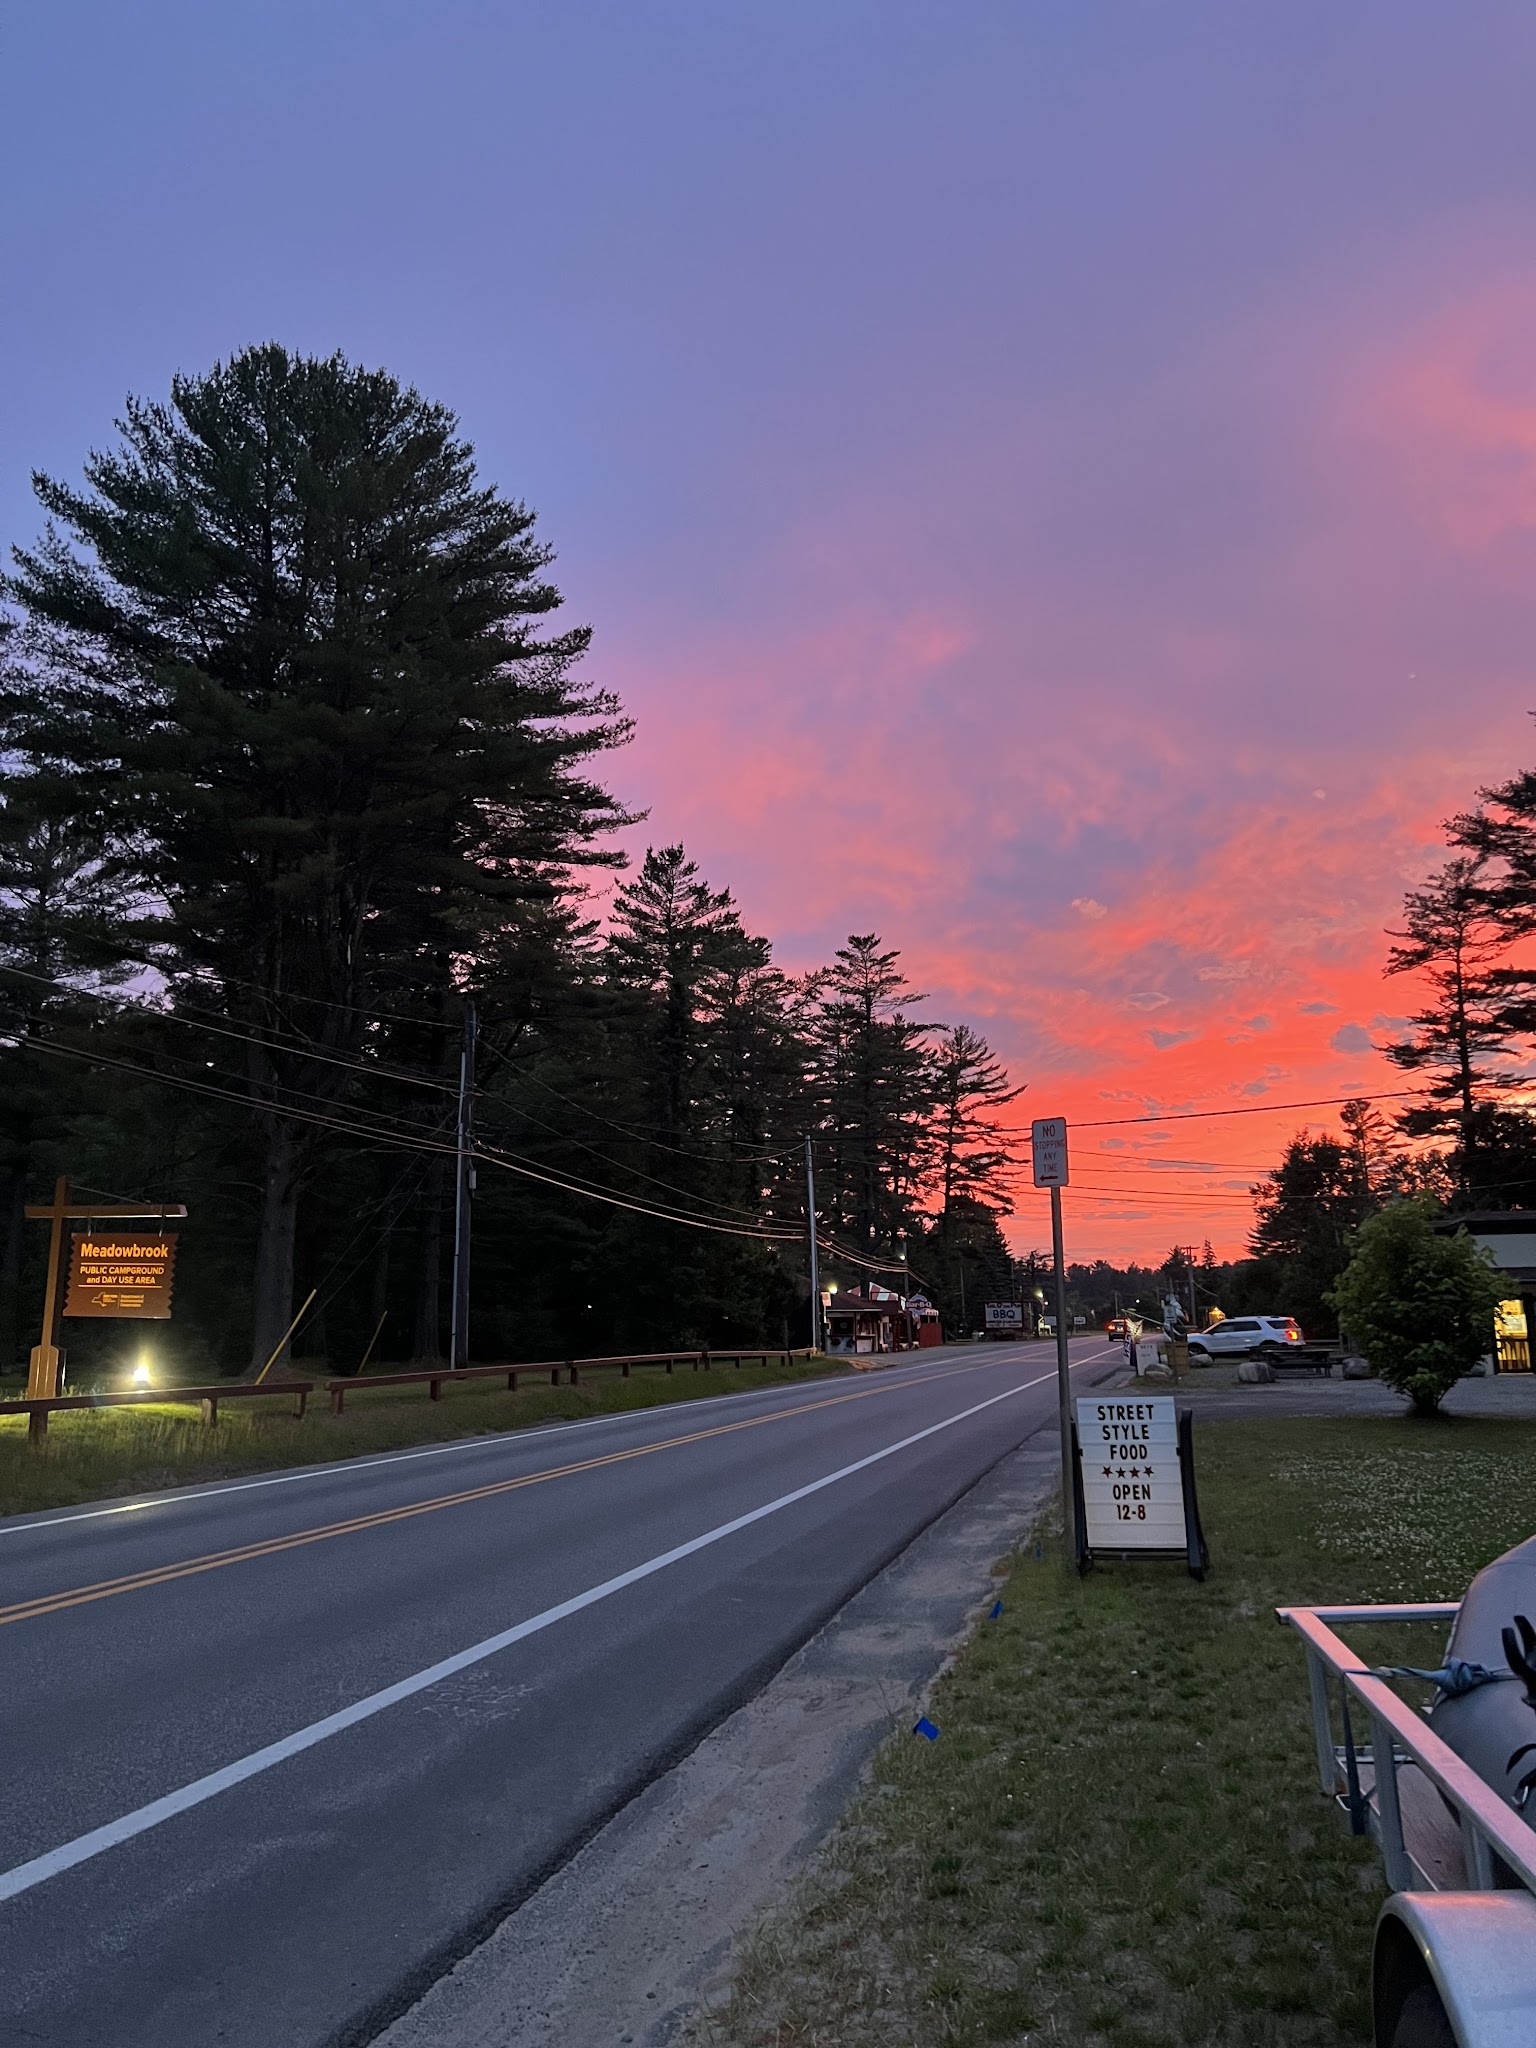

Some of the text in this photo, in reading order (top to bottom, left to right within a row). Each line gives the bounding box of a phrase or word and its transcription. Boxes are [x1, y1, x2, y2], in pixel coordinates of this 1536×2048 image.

[1042, 1124, 1056, 1138] NO
[1035, 1139, 1065, 1150] STOPPING
[1043, 1151, 1057, 1161] ANY
[1043, 1163, 1058, 1173] TIME
[80, 1243, 168, 1258] Meadowbrook
[80, 1266, 165, 1275] PUBLIC CAMPGROUND
[86, 1275, 156, 1284] and DAY USE AREA
[992, 1309, 1015, 1319] BBQ
[1097, 1404, 1154, 1421] STREET
[1102, 1424, 1150, 1441] STYLE
[1110, 1444, 1148, 1460] FOOD
[1112, 1484, 1151, 1500] OPEN
[1116, 1504, 1146, 1520] 12-8
